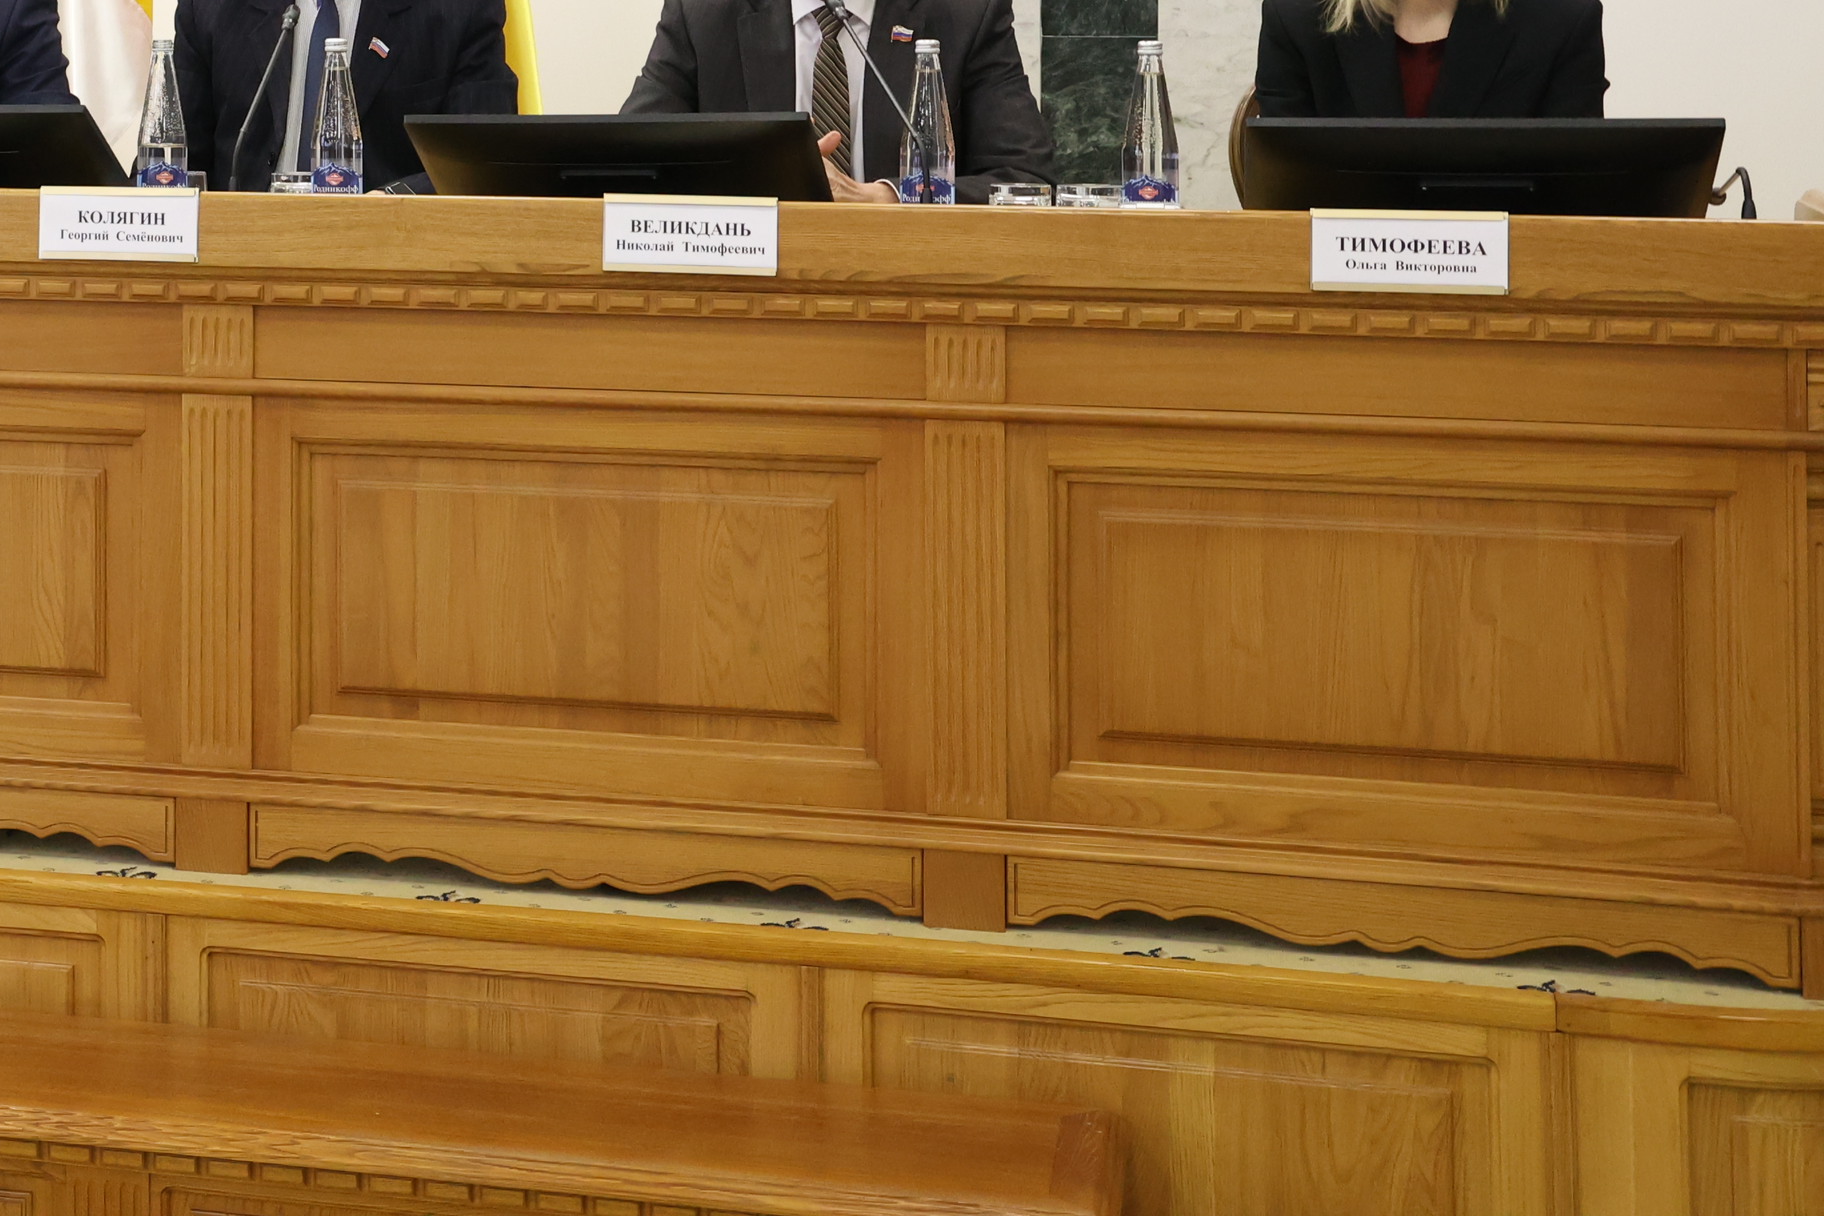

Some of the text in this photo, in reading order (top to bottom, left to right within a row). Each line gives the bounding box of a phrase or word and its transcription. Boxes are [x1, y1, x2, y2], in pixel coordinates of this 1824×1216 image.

[78, 210, 166, 226] КОЛЯГИН
[60, 229, 183, 244] Георгий Семёнович
[631, 219, 752, 237] ВЕЛИКДАНЬ
[616, 239, 766, 256] Николай Тимофеевич
[1336, 236, 1487, 256] ТИМОФЕЕВА
[1345, 258, 1477, 275] Ольга Викторовна
